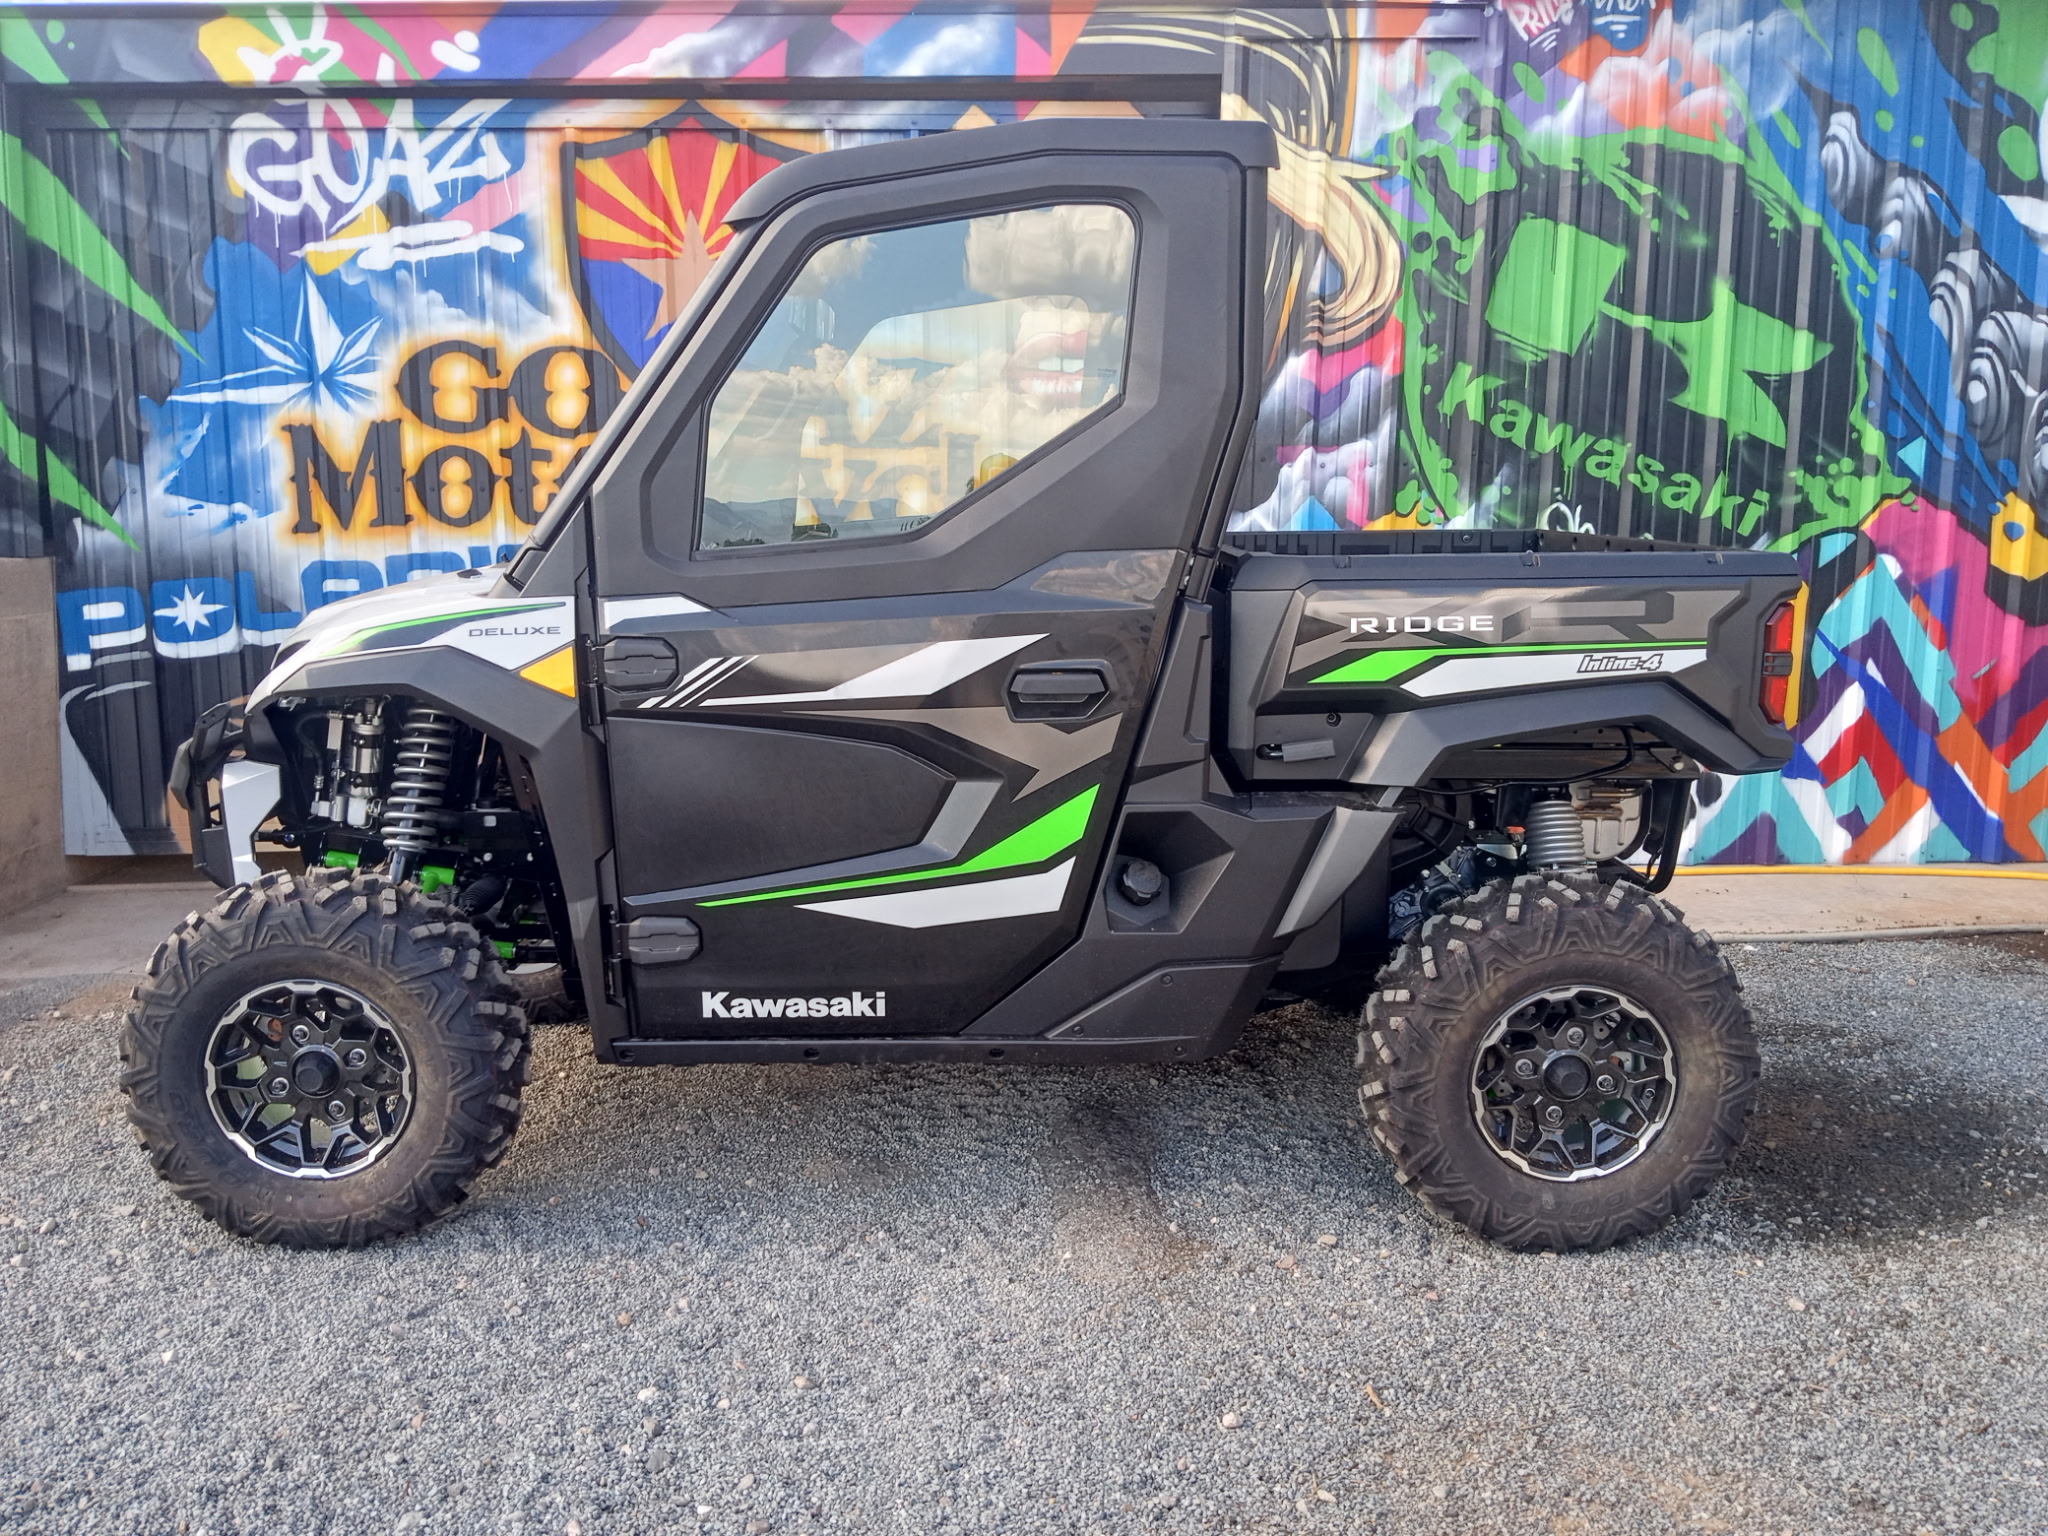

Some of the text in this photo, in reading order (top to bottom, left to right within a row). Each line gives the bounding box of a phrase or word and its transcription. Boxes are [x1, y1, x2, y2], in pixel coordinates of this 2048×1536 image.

[396, 340, 627, 438] GO
[1437, 361, 1770, 537] Kawasaki
[281, 418, 595, 534] Mot
[468, 626, 561, 638] DELUXE
[1350, 615, 1494, 634] RIDGE
[1577, 653, 1664, 673] Inline-4
[701, 991, 886, 1018] Kawasaki
